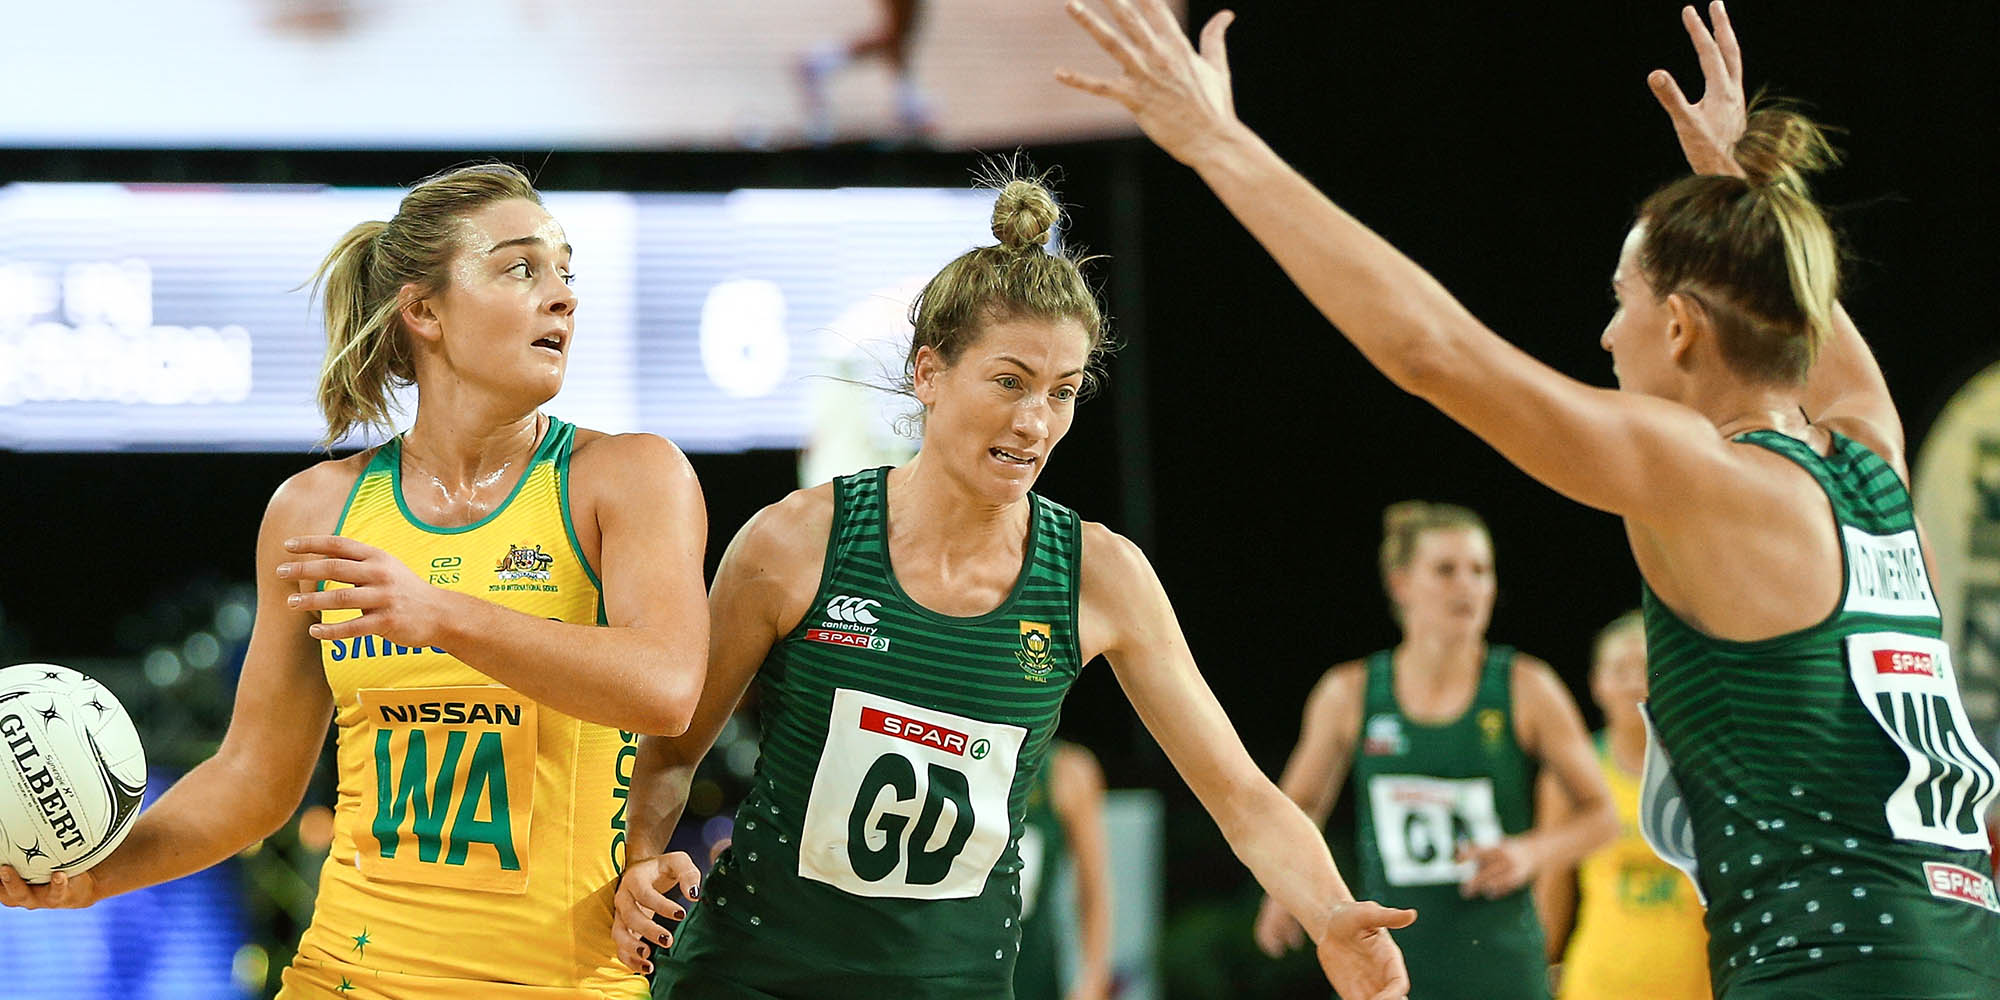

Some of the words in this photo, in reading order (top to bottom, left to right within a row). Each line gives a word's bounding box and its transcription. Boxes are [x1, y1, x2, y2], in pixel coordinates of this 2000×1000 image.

[429, 573, 461, 585] F&S
[818, 632, 868, 646] SPAR
[821, 621, 878, 636] canterbury
[1891, 652, 1932, 673] SPAR
[379, 702, 521, 726] NISSAN
[883, 717, 965, 752] SPAR
[0, 713, 87, 851] GILBERT
[372, 728, 522, 871] WA
[847, 752, 976, 886] GD
[1932, 869, 1984, 900] SPAR
